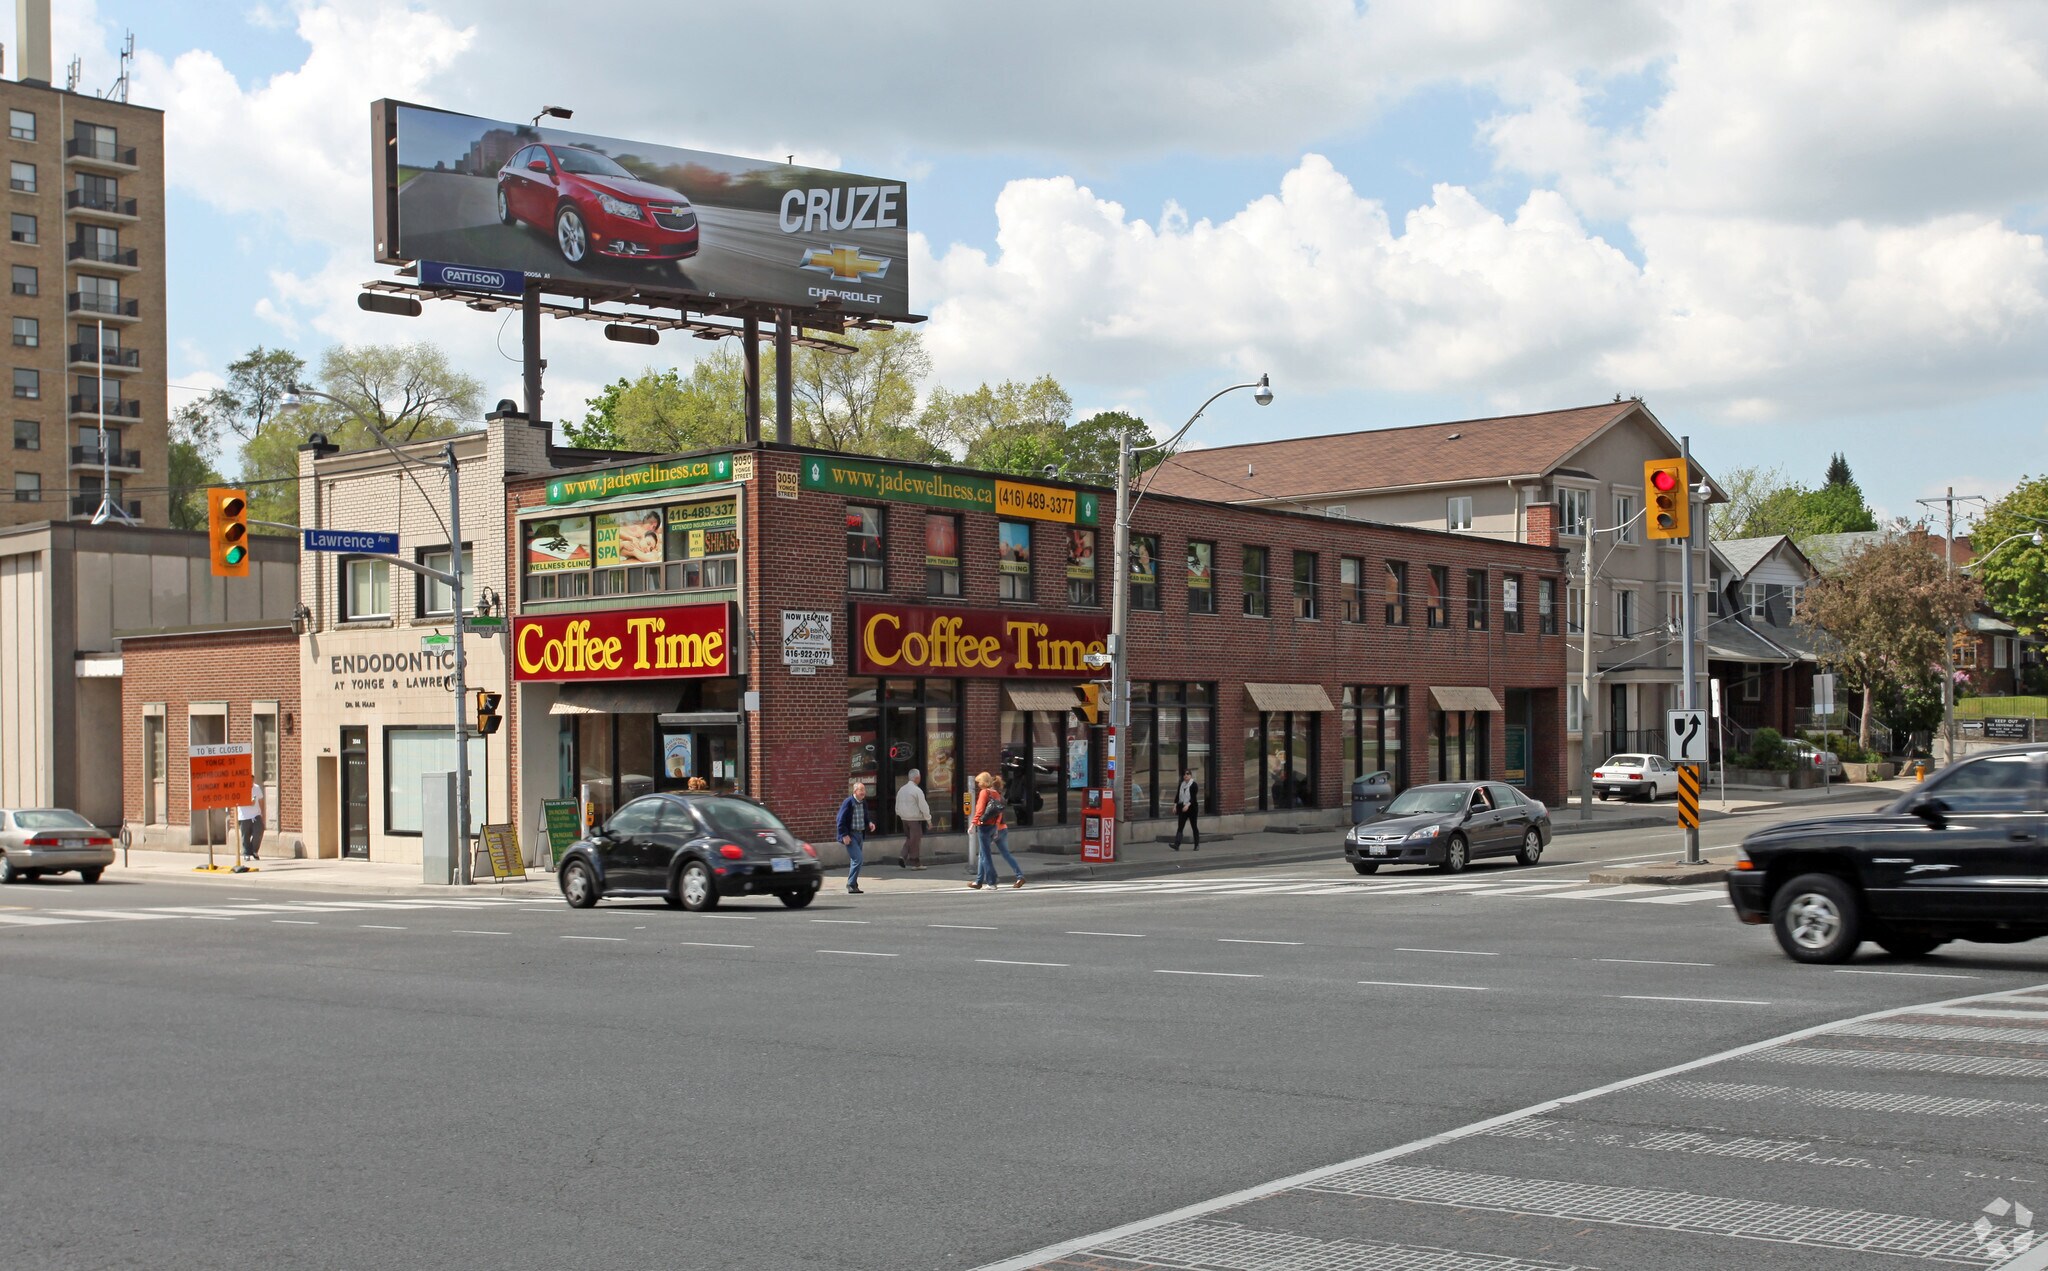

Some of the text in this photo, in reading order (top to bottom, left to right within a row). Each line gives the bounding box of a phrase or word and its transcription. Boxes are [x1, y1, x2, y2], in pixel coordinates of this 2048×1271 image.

[779, 185, 901, 233] CRUZE
[446, 270, 500, 285] PATTISON
[808, 287, 883, 303] CHEVROLET
[733, 454, 752, 467] 3050
[563, 462, 710, 496] www.jadewellness.ca
[734, 472, 752, 480] STREET
[777, 472, 797, 485] 3050
[779, 484, 796, 492] YONGE
[831, 467, 993, 504] www.jadewellness.ca
[777, 490, 797, 498] STREET
[999, 486, 1075, 516] (416) 489-3377
[668, 502, 737, 521] 416-489-337
[671, 522, 693, 531] EXTENDED
[692, 520, 716, 529] INSURANCE
[310, 531, 391, 549] Lawrence Ave
[597, 528, 618, 543] DAY
[597, 545, 618, 560] SPA
[529, 559, 591, 571] WELLNESS CLINIC
[785, 613, 802, 621] NOW
[467, 624, 490, 632] Lawrence
[517, 619, 623, 674] Coffee
[627, 617, 724, 670] Time
[863, 613, 1107, 671] Coffee Time
[785, 649, 831, 659] 416-922-0777
[334, 681, 344, 690] AT
[351, 678, 385, 690] YONGE
[219, 745, 244, 754] CLOSED
[205, 758, 225, 766] YONGE
[192, 769, 250, 779] SOUTHBOUND LANES
[196, 783, 220, 791] SUNDAY
[239, 780, 246, 788] 13
